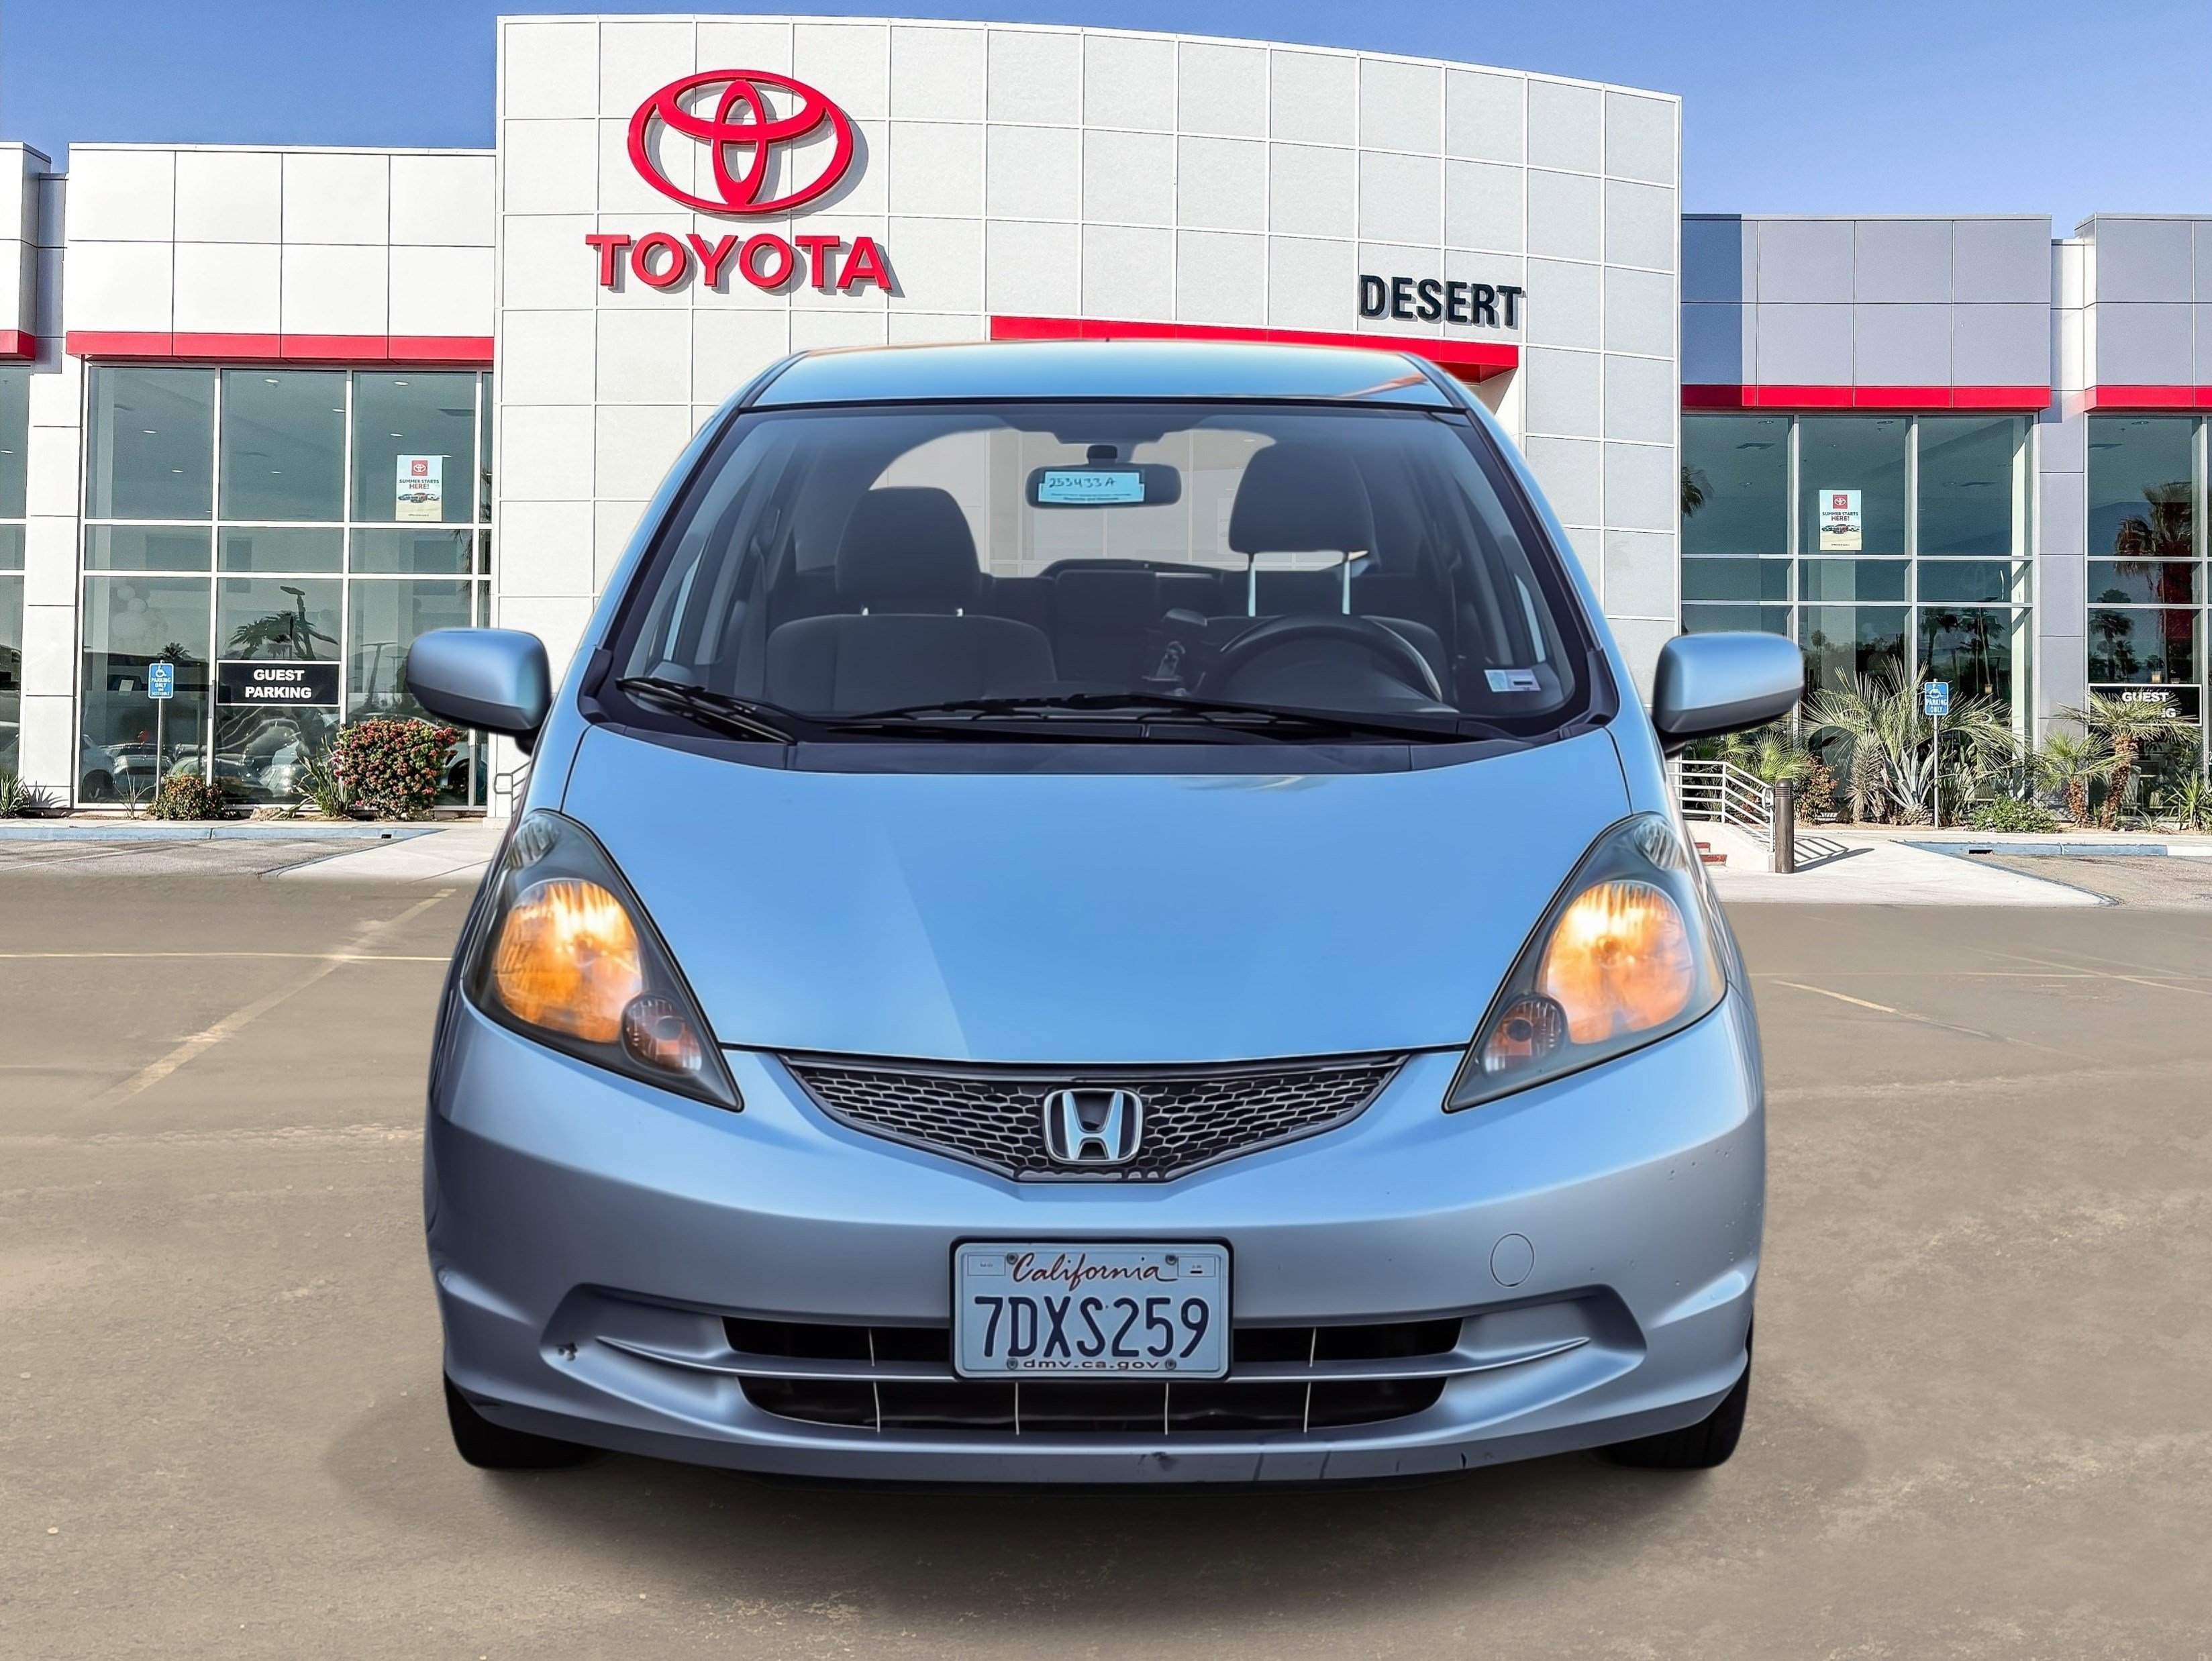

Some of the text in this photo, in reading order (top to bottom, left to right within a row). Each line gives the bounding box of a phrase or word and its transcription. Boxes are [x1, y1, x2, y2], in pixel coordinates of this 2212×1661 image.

[585, 232, 893, 291] TOYOTA
[1359, 274, 1522, 327] DESERT
[253, 669, 305, 681] GUEST
[244, 686, 312, 699] PARKING
[2121, 692, 2170, 702] GUEST
[1012, 1252, 1178, 1291] California
[974, 1296, 1209, 1358] 7DXS259
[1023, 1358, 1160, 1370] dmv.ca.gov
